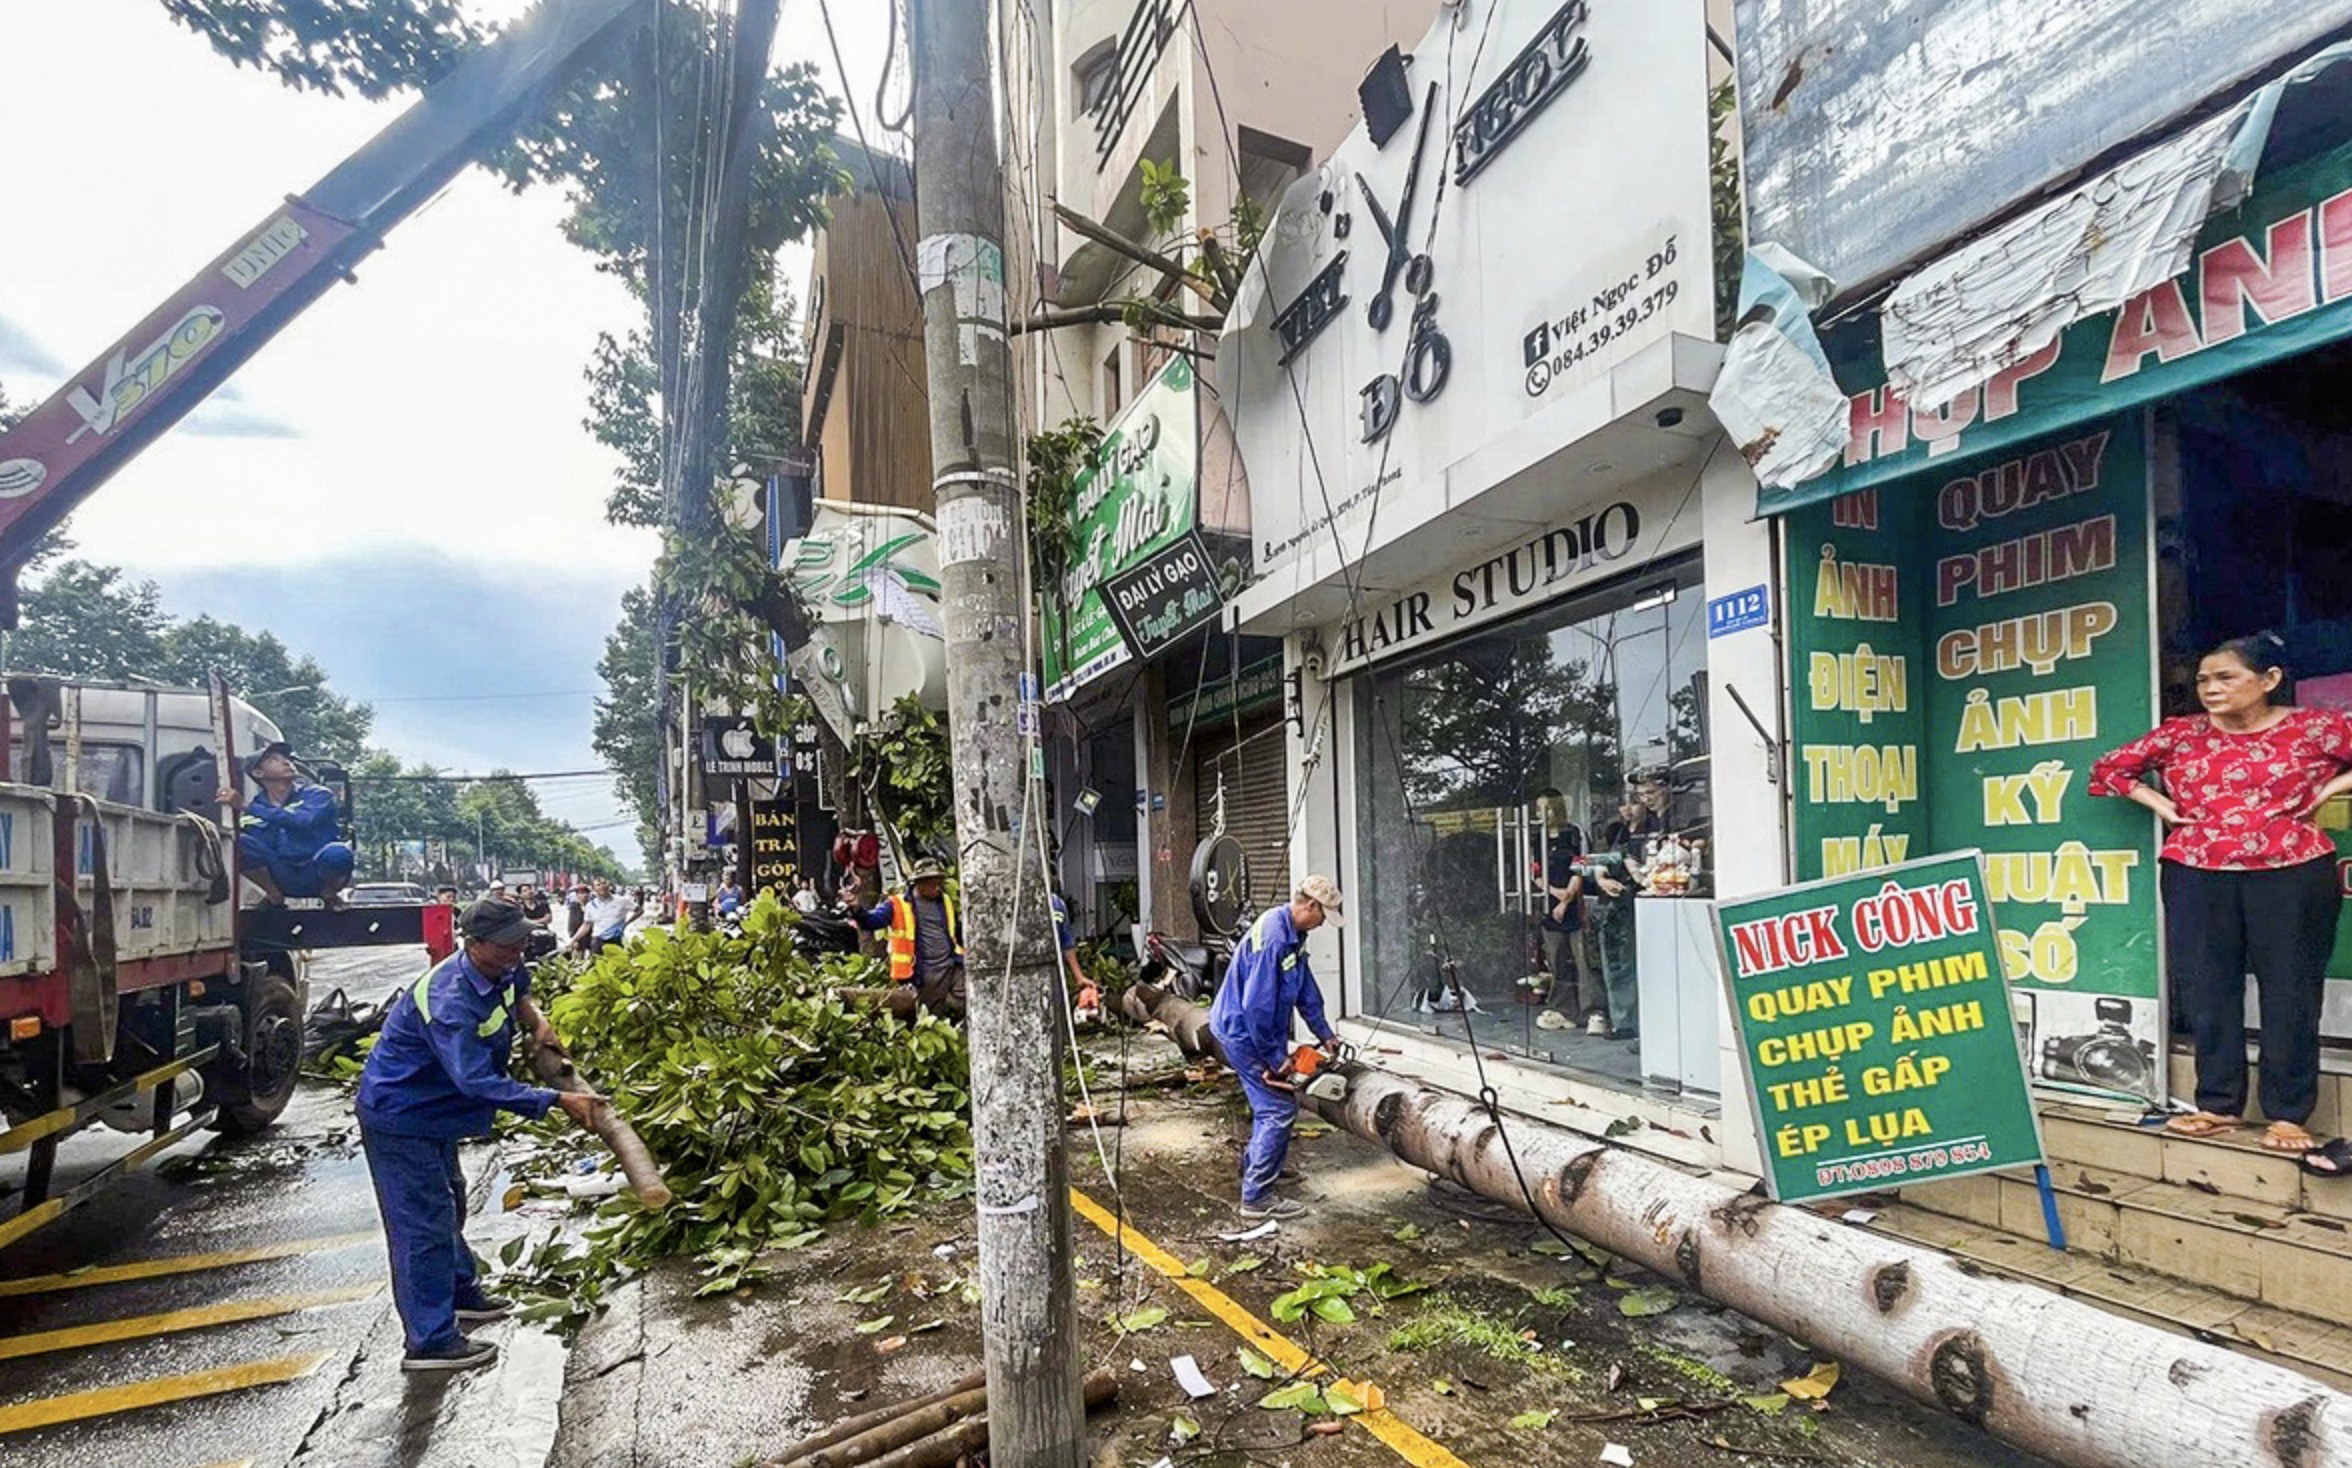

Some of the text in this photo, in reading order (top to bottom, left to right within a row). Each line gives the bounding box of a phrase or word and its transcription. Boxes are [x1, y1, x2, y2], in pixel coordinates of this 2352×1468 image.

[1552, 308, 1587, 341] Việt
[1592, 273, 1639, 316] Ngọc
[1553, 280, 1679, 377] 084.39.39.379
[1938, 431, 2109, 530] QUAY
[1119, 580, 1149, 610] ĐẠI
[1163, 552, 1199, 582] GẠO
[1342, 590, 1435, 663] HAIR
[1453, 501, 1641, 621] STUDIO
[1814, 544, 1898, 621] ẢNH
[1938, 513, 2117, 607] PHIM
[1716, 593, 1761, 621] 1112
[1938, 602, 2118, 681] CHỤP
[1809, 644, 1907, 724] ĐIỆN
[1955, 687, 2097, 754] ẢNH
[1803, 744, 1918, 813] THOẠI
[1983, 760, 2073, 827] KỸ
[1730, 879, 1979, 977] NICK CÔNG
[1748, 951, 1989, 1023] QUAY PHIM
[1758, 1001, 1985, 1067] CHỤP ẢNH
[1767, 1051, 1952, 1112] THẺ GẤP
[1775, 1108, 1932, 1158] ÉP LỤA
[1950, 1141, 1992, 1165] 854
